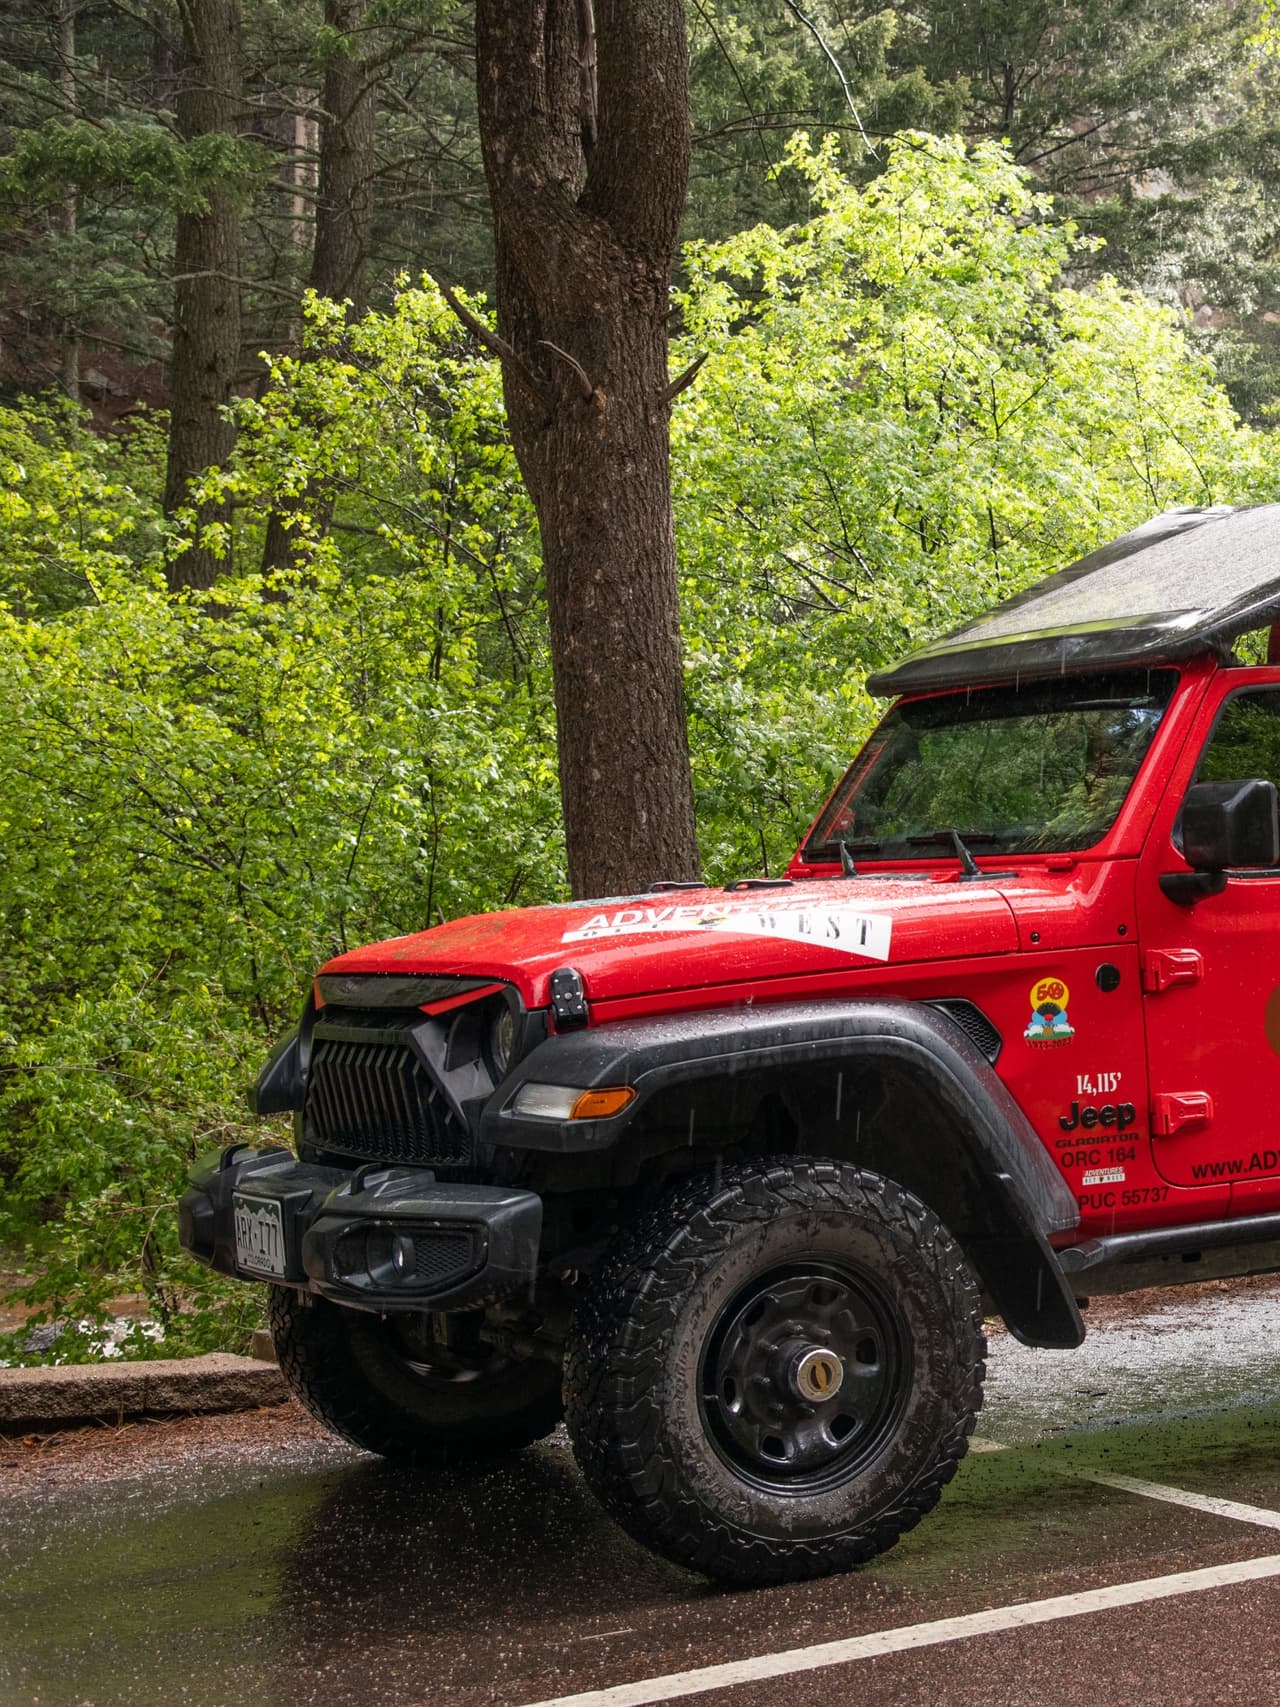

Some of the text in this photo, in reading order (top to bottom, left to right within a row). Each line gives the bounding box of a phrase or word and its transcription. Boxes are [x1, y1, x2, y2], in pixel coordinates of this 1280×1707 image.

[1036, 982, 1065, 1001] 50
[1059, 1101, 1136, 1130] Jeep
[1055, 1132, 1139, 1149] GLADIATOR
[1061, 1145, 1136, 1168] ORC 164
[1085, 1166, 1124, 1177] ADVENTURES
[1078, 1186, 1169, 1210] PUC 55737
